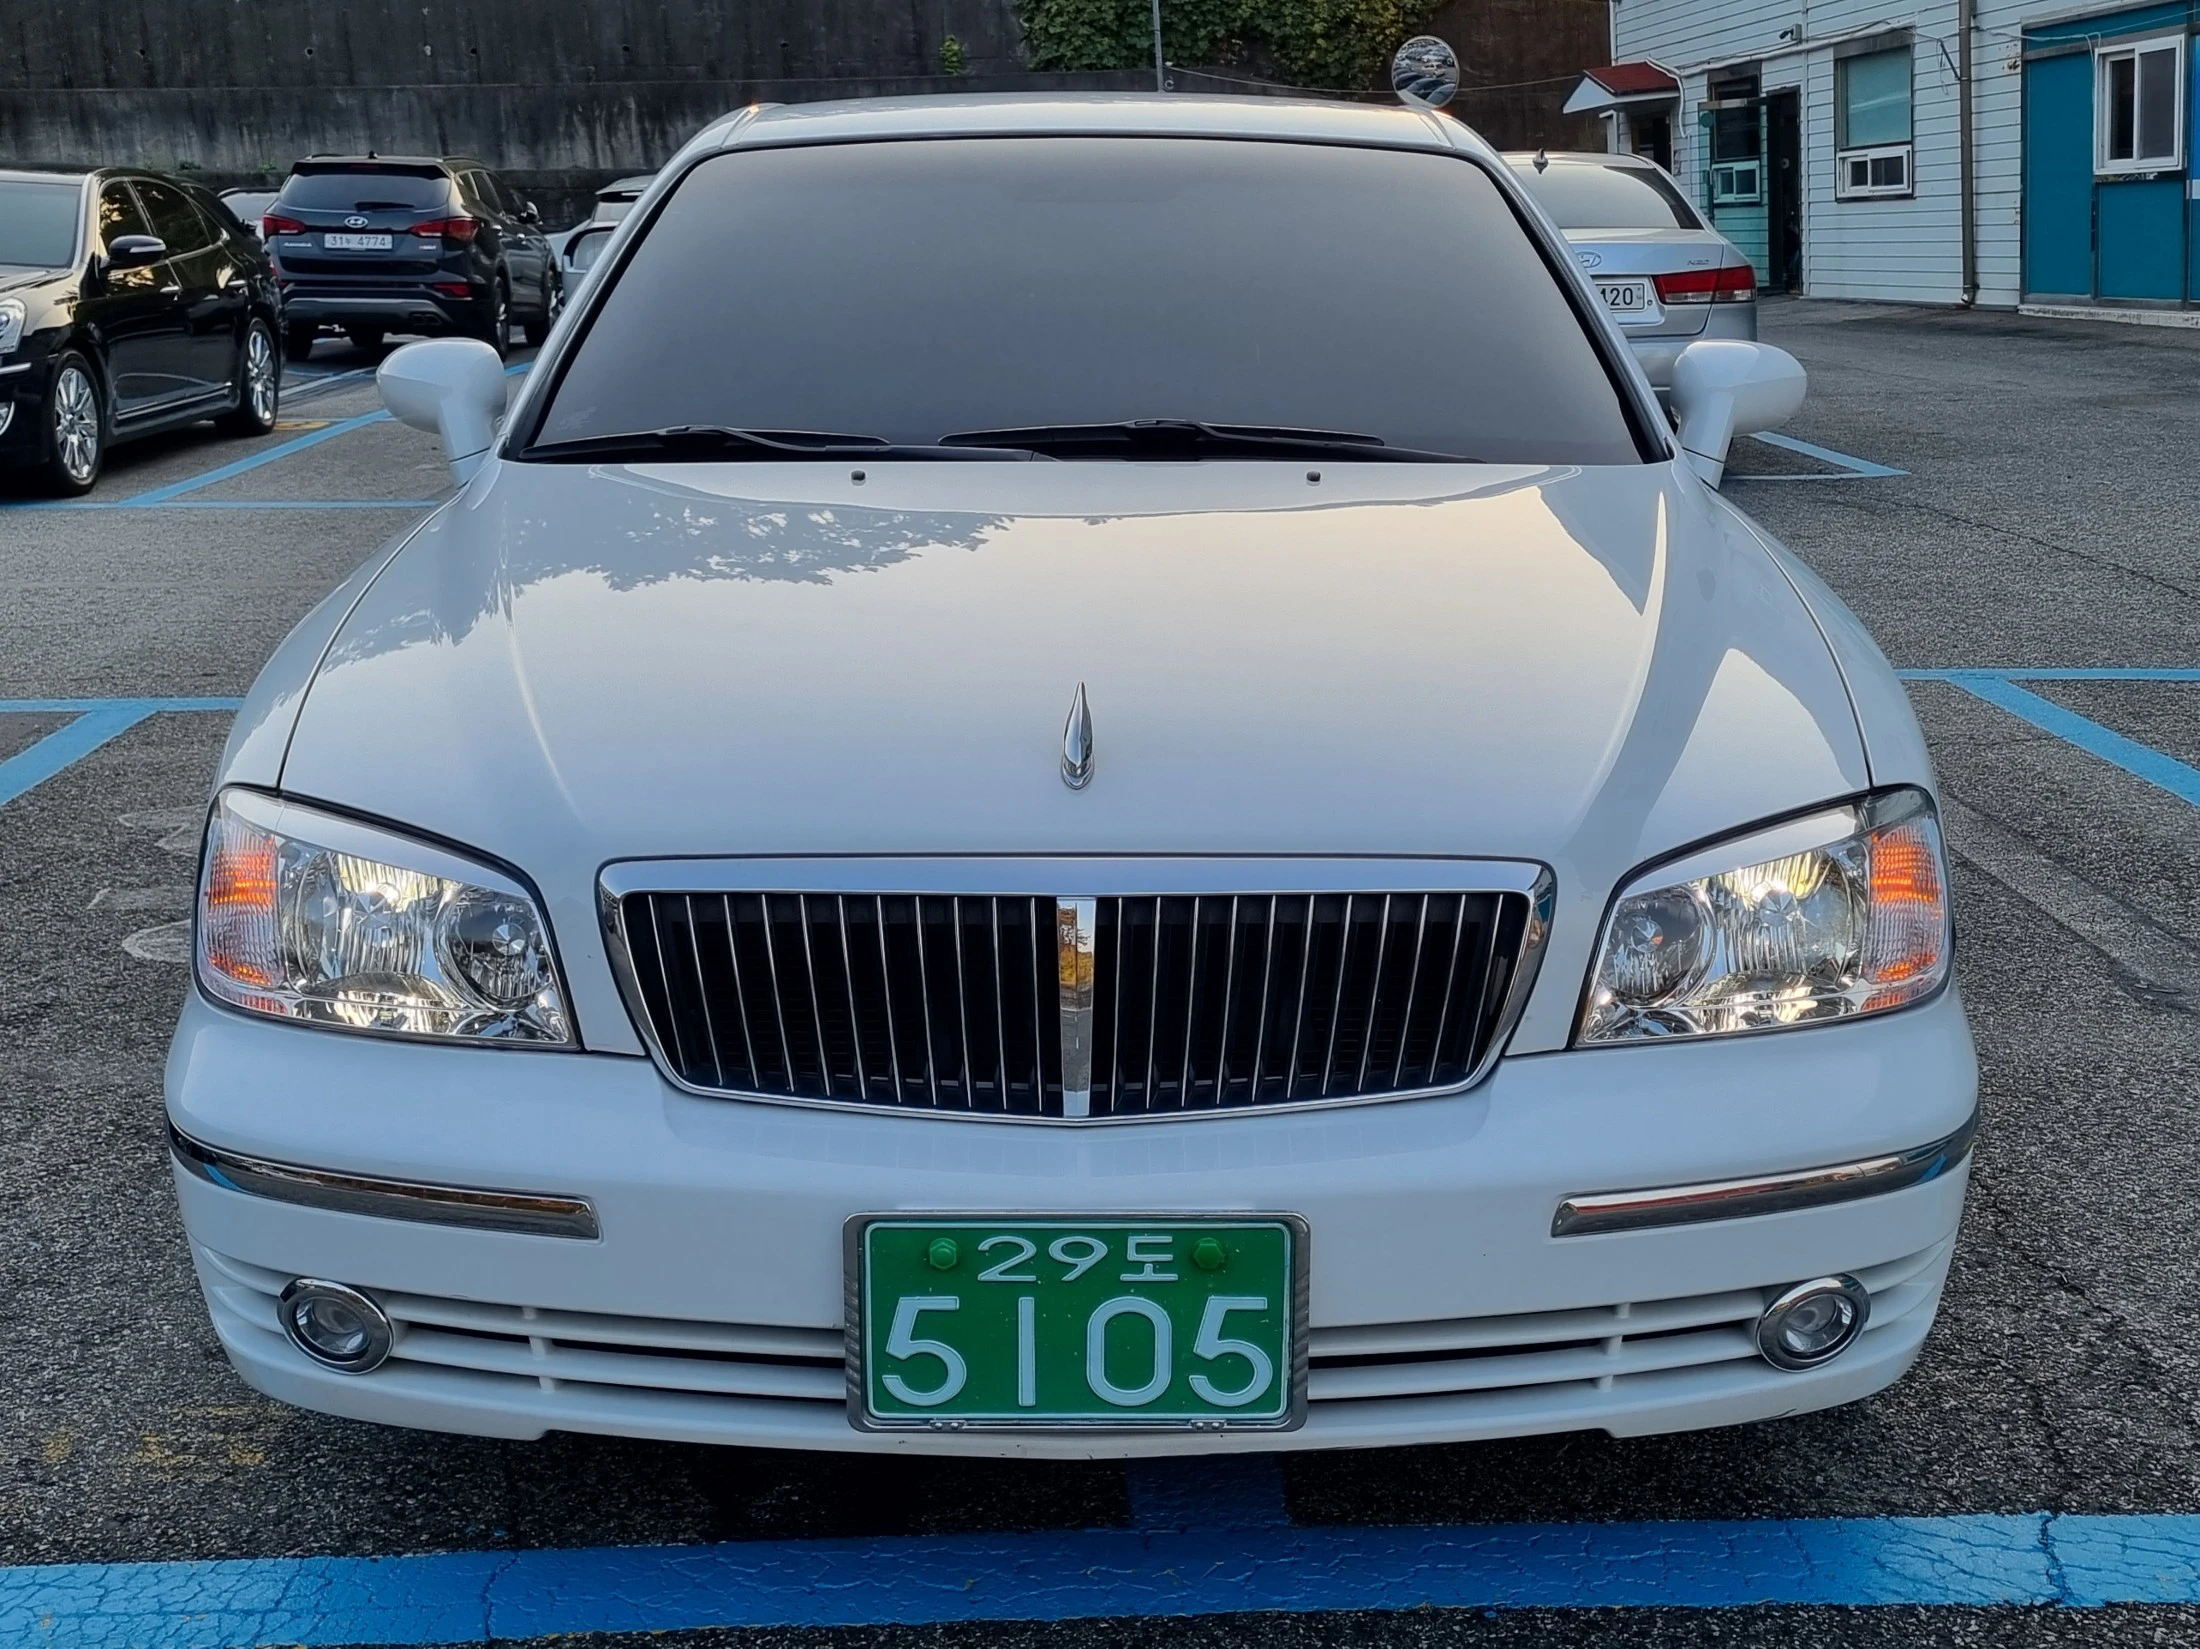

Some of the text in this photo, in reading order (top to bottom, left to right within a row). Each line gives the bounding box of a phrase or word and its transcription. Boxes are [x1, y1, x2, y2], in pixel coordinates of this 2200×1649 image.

[357, 236, 387, 248] 4774
[977, 1235, 1178, 1282] 29도
[881, 1296, 1274, 1407] 5105
